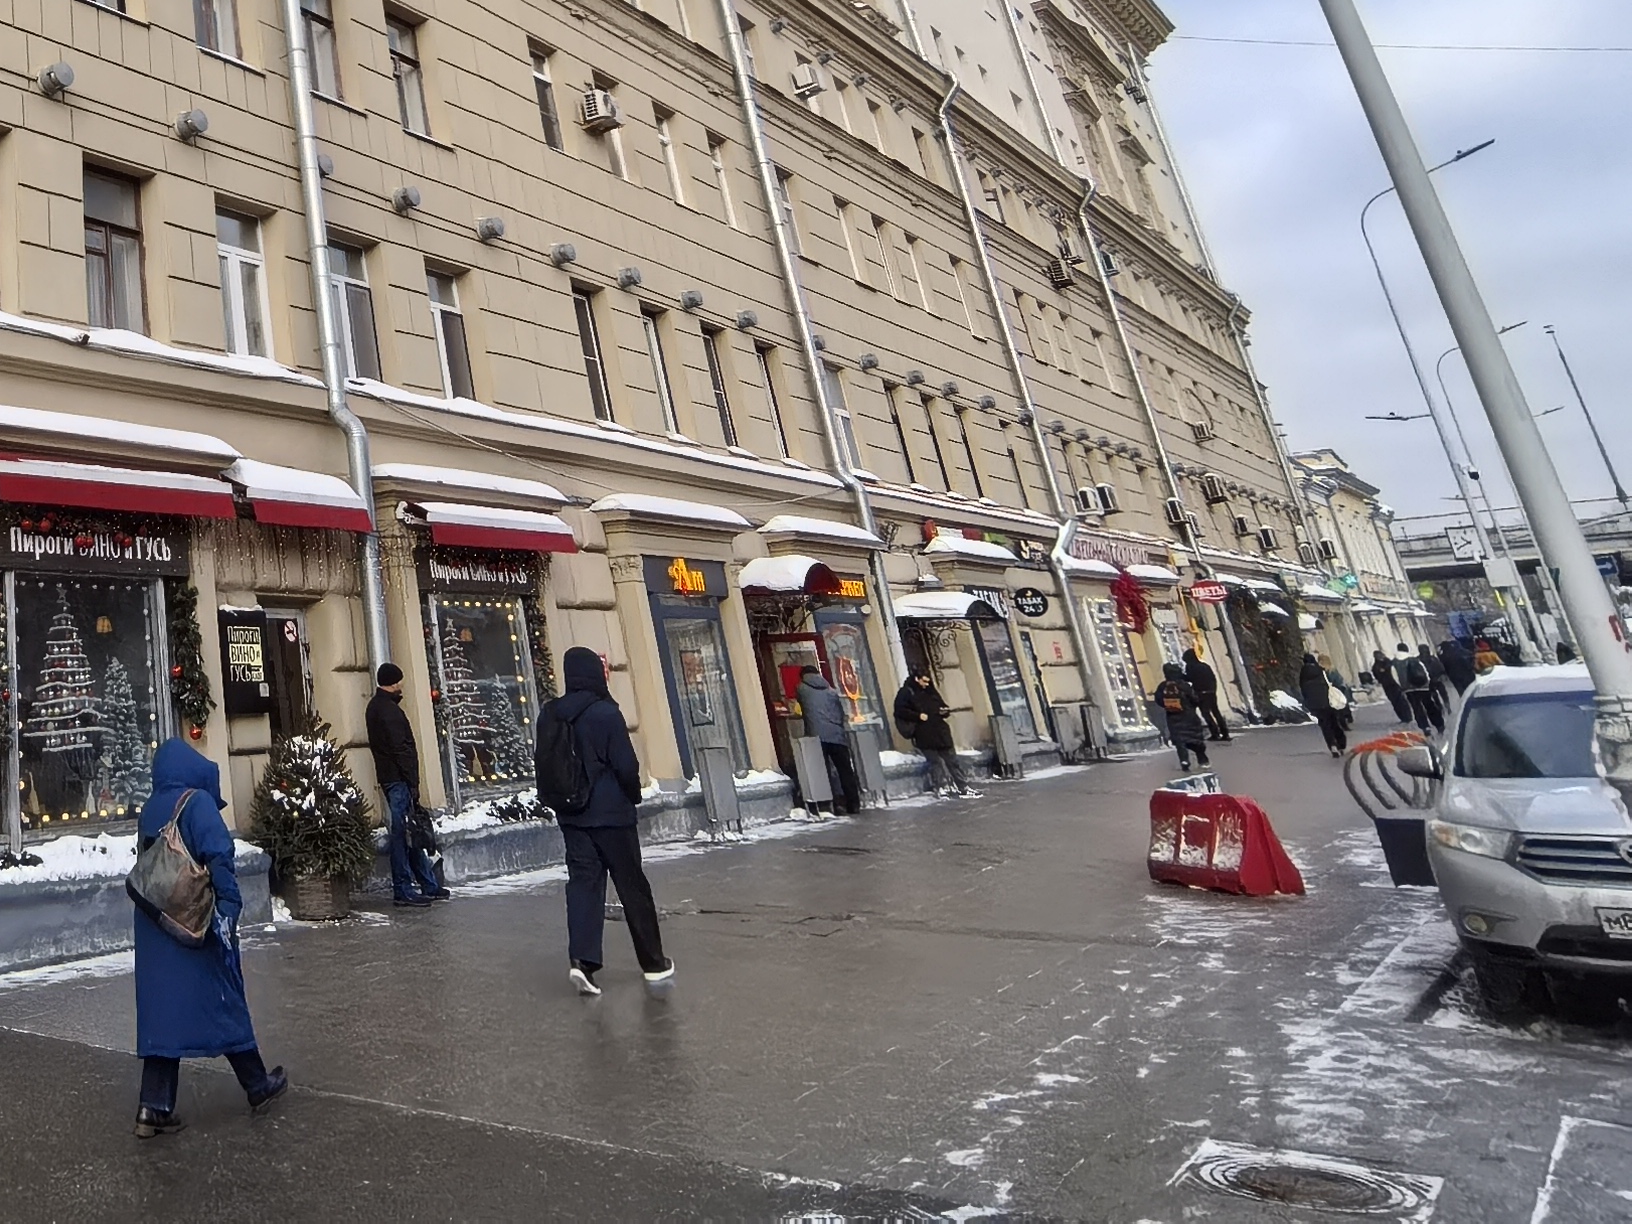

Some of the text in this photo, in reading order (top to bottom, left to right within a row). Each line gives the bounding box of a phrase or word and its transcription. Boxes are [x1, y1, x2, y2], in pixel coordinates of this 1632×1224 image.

[10, 526, 74, 560] Пироги
[231, 645, 255, 663] ВИНО
[230, 664, 251, 682] ГУСЬ
